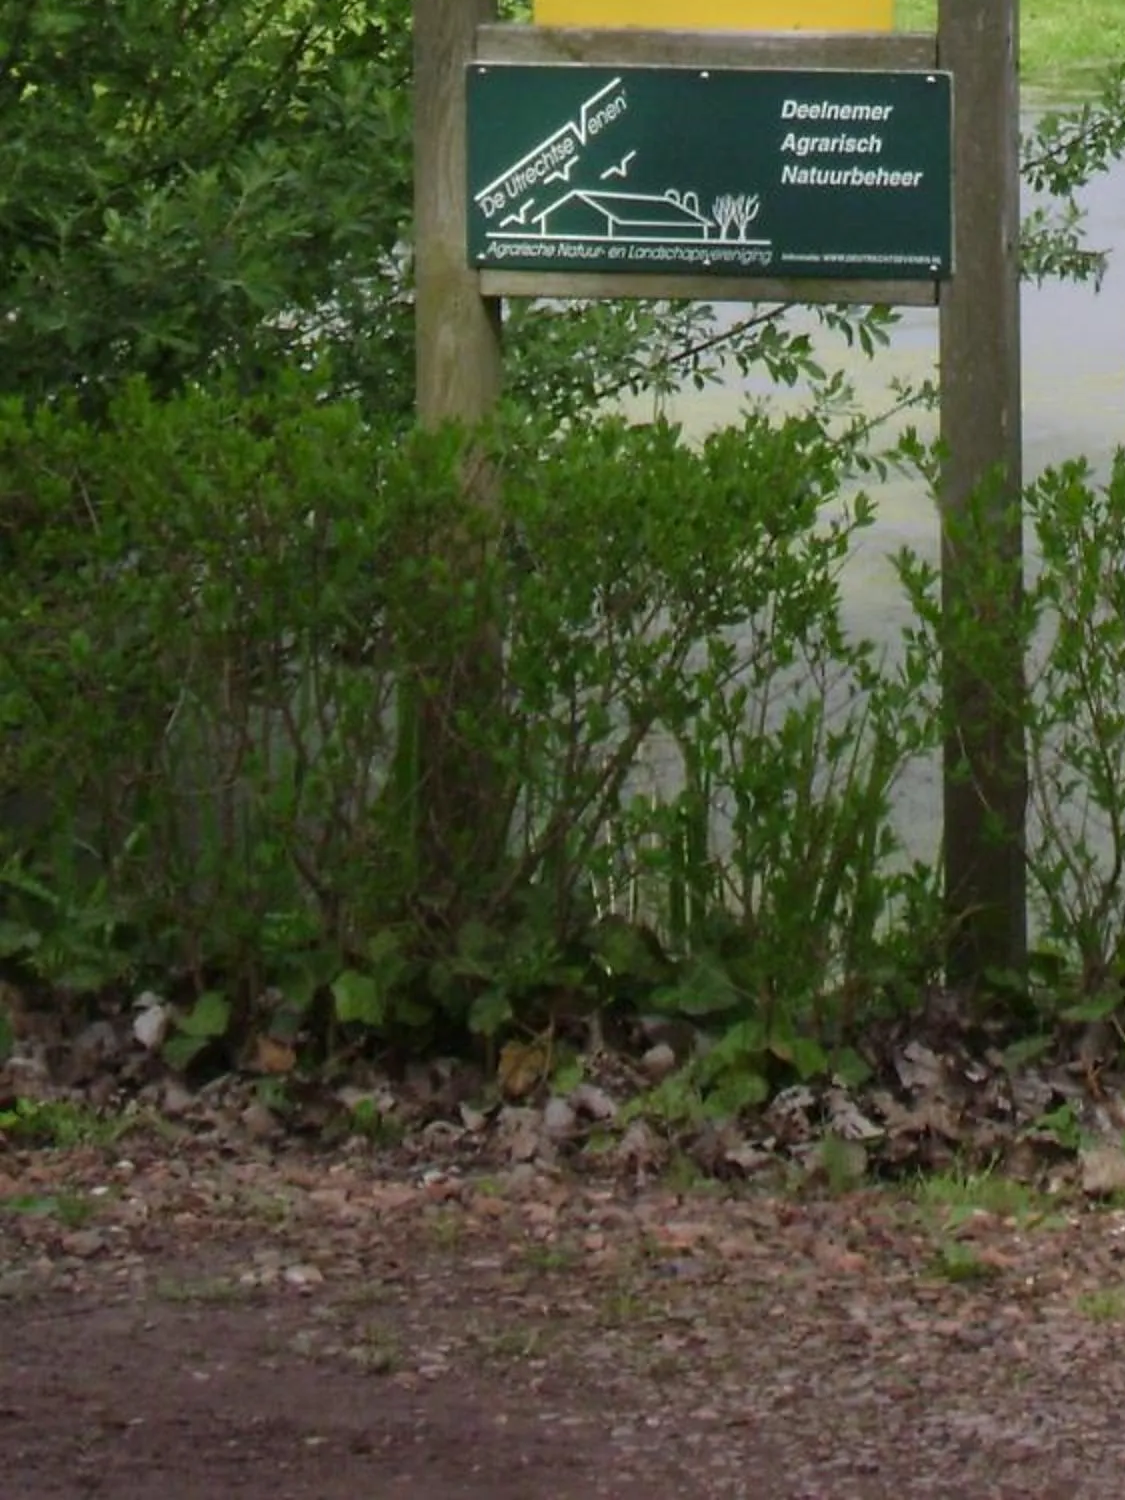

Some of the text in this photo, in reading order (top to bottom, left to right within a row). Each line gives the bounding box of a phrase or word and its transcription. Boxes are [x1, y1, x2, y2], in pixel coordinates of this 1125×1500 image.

[781, 100, 893, 121] Deelnemer
[780, 132, 883, 157] Agrarisch
[504, 137, 575, 198] Utrechtse
[781, 164, 923, 188] Natuurbeheer
